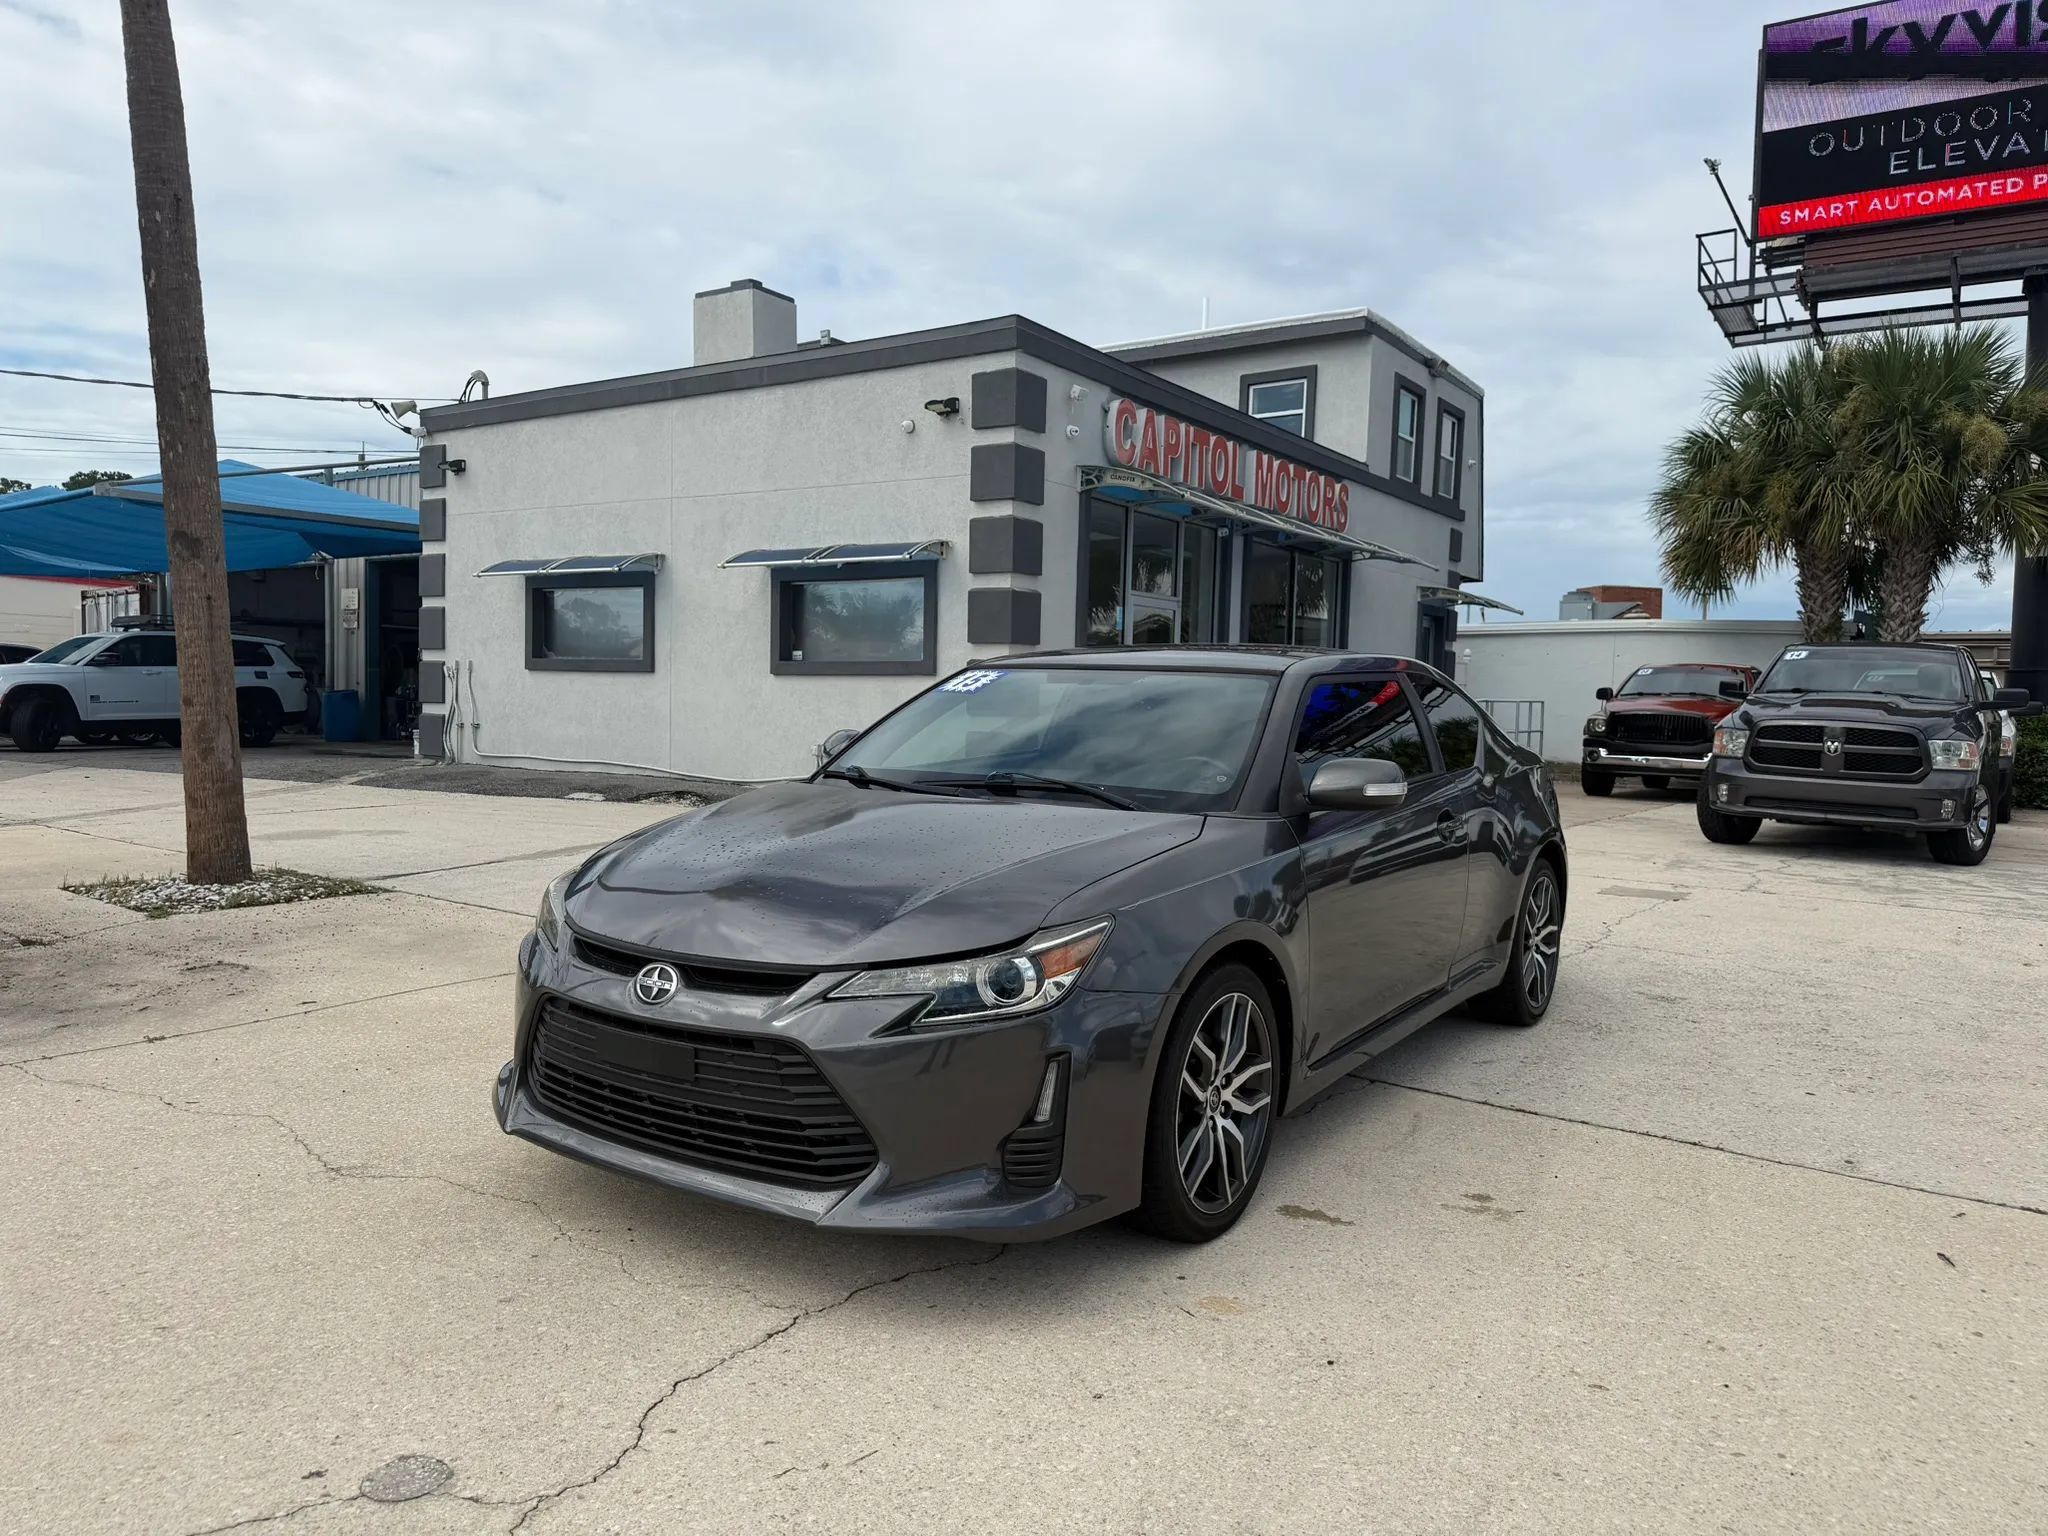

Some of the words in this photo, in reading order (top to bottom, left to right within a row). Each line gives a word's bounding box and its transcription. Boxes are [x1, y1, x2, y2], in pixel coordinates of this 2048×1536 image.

[1808, 0, 2048, 86] kyvi
[1808, 98, 2032, 157] OUTDOOR
[1779, 200, 1859, 225] SMART
[1867, 177, 2024, 213] AUTOMATED
[1112, 398, 1246, 502] CAPITOL
[1253, 450, 1350, 535] MOTORS
